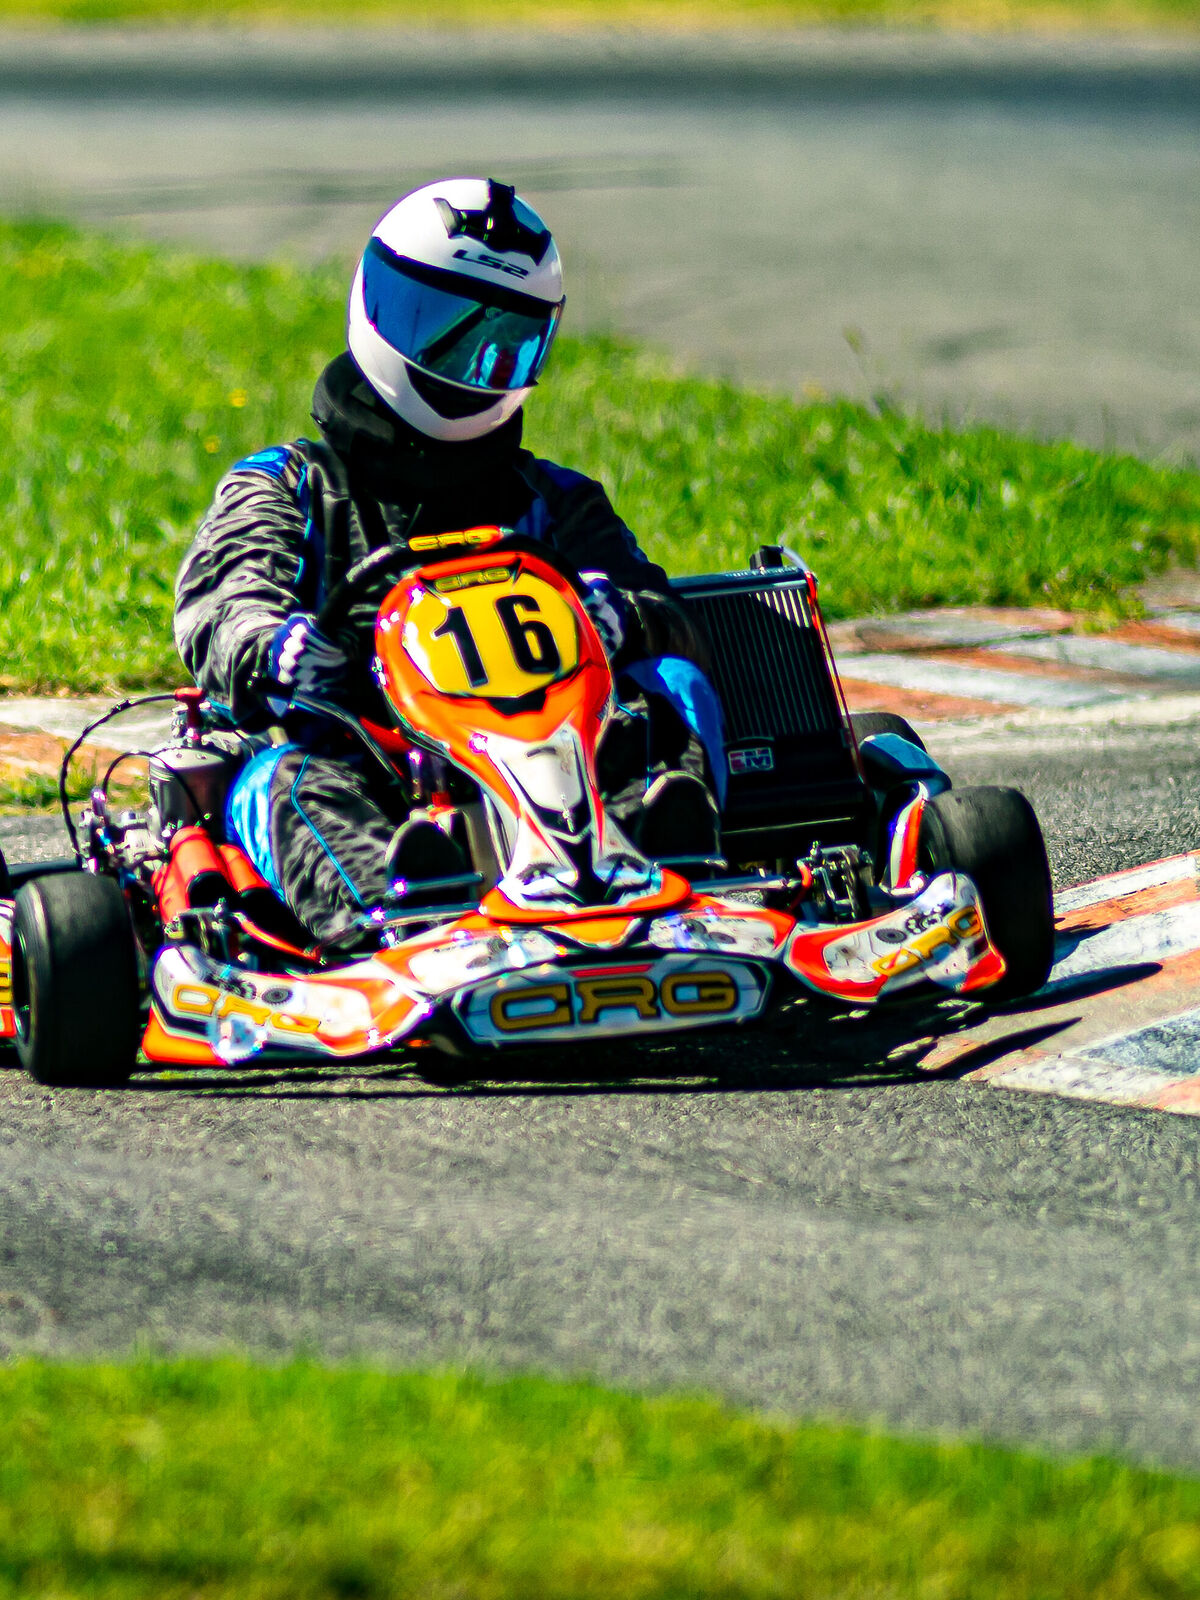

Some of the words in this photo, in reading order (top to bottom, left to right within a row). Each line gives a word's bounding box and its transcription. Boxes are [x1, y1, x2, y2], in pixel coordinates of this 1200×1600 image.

[452, 249, 529, 279] LS2
[431, 594, 561, 688] 16
[489, 970, 739, 1032] CRG
